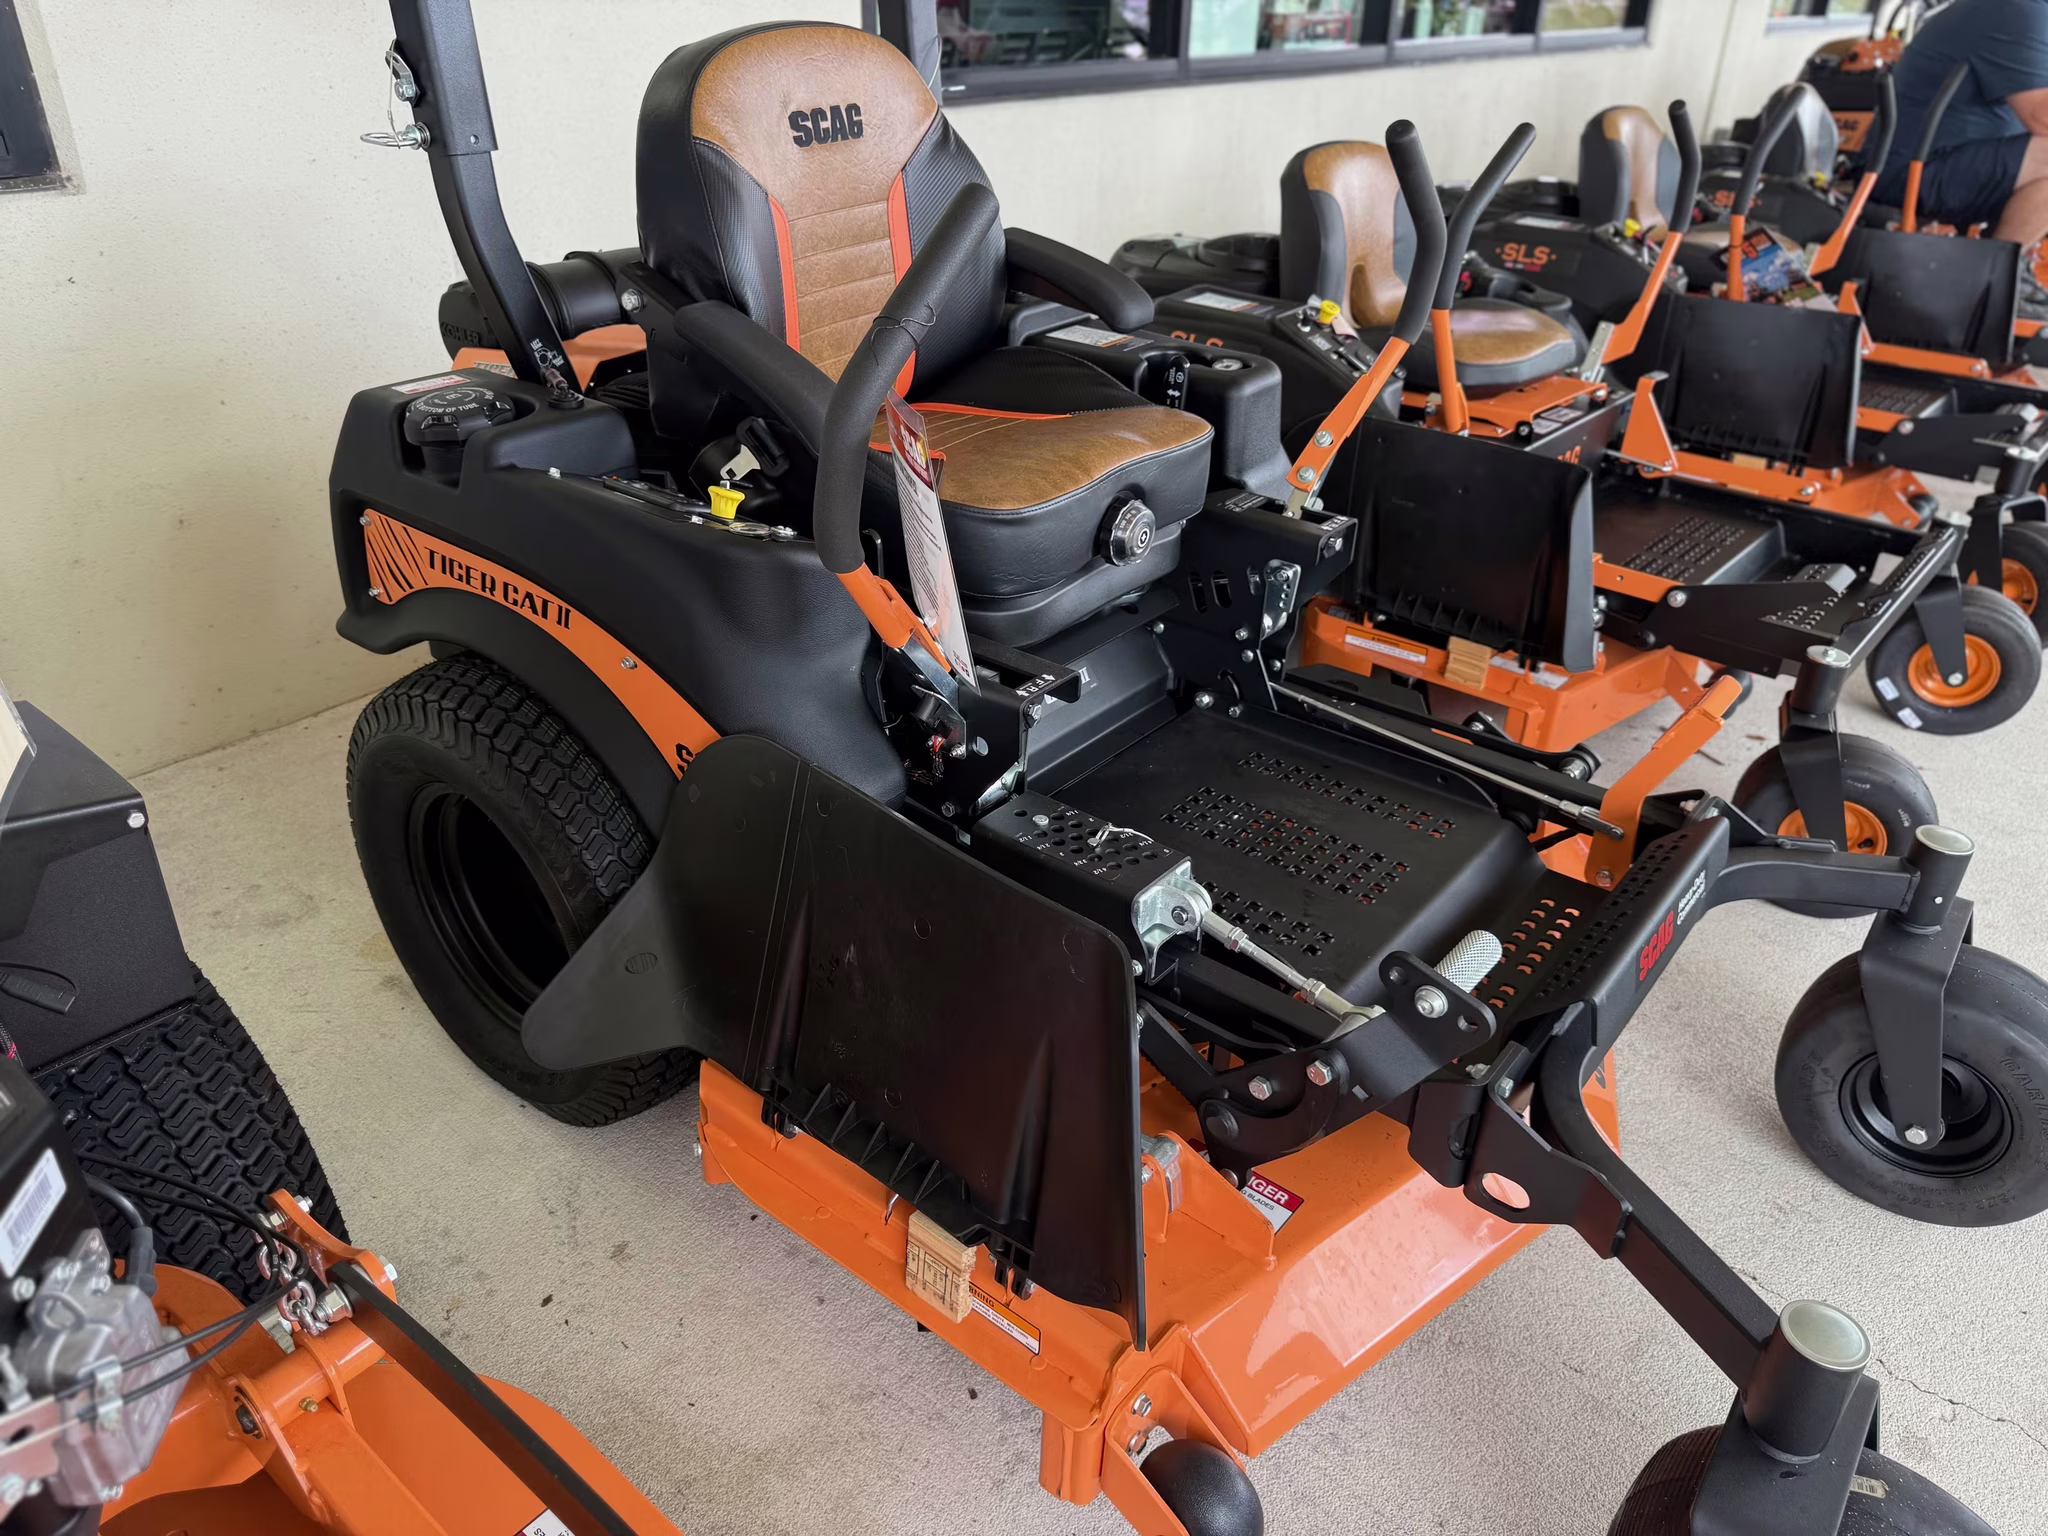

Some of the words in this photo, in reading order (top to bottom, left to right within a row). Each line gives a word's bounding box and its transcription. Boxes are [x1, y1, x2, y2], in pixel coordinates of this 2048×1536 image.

[787, 103, 864, 148] SCAG
[1501, 242, 1551, 265] SLS
[440, 322, 481, 345] KOHLER
[458, 402, 480, 411] TUBE
[423, 546, 497, 598] TIGER
[502, 581, 555, 620] CAT
[1638, 910, 1675, 982] SCAG
[1247, 1192, 1275, 1212] BLADES
